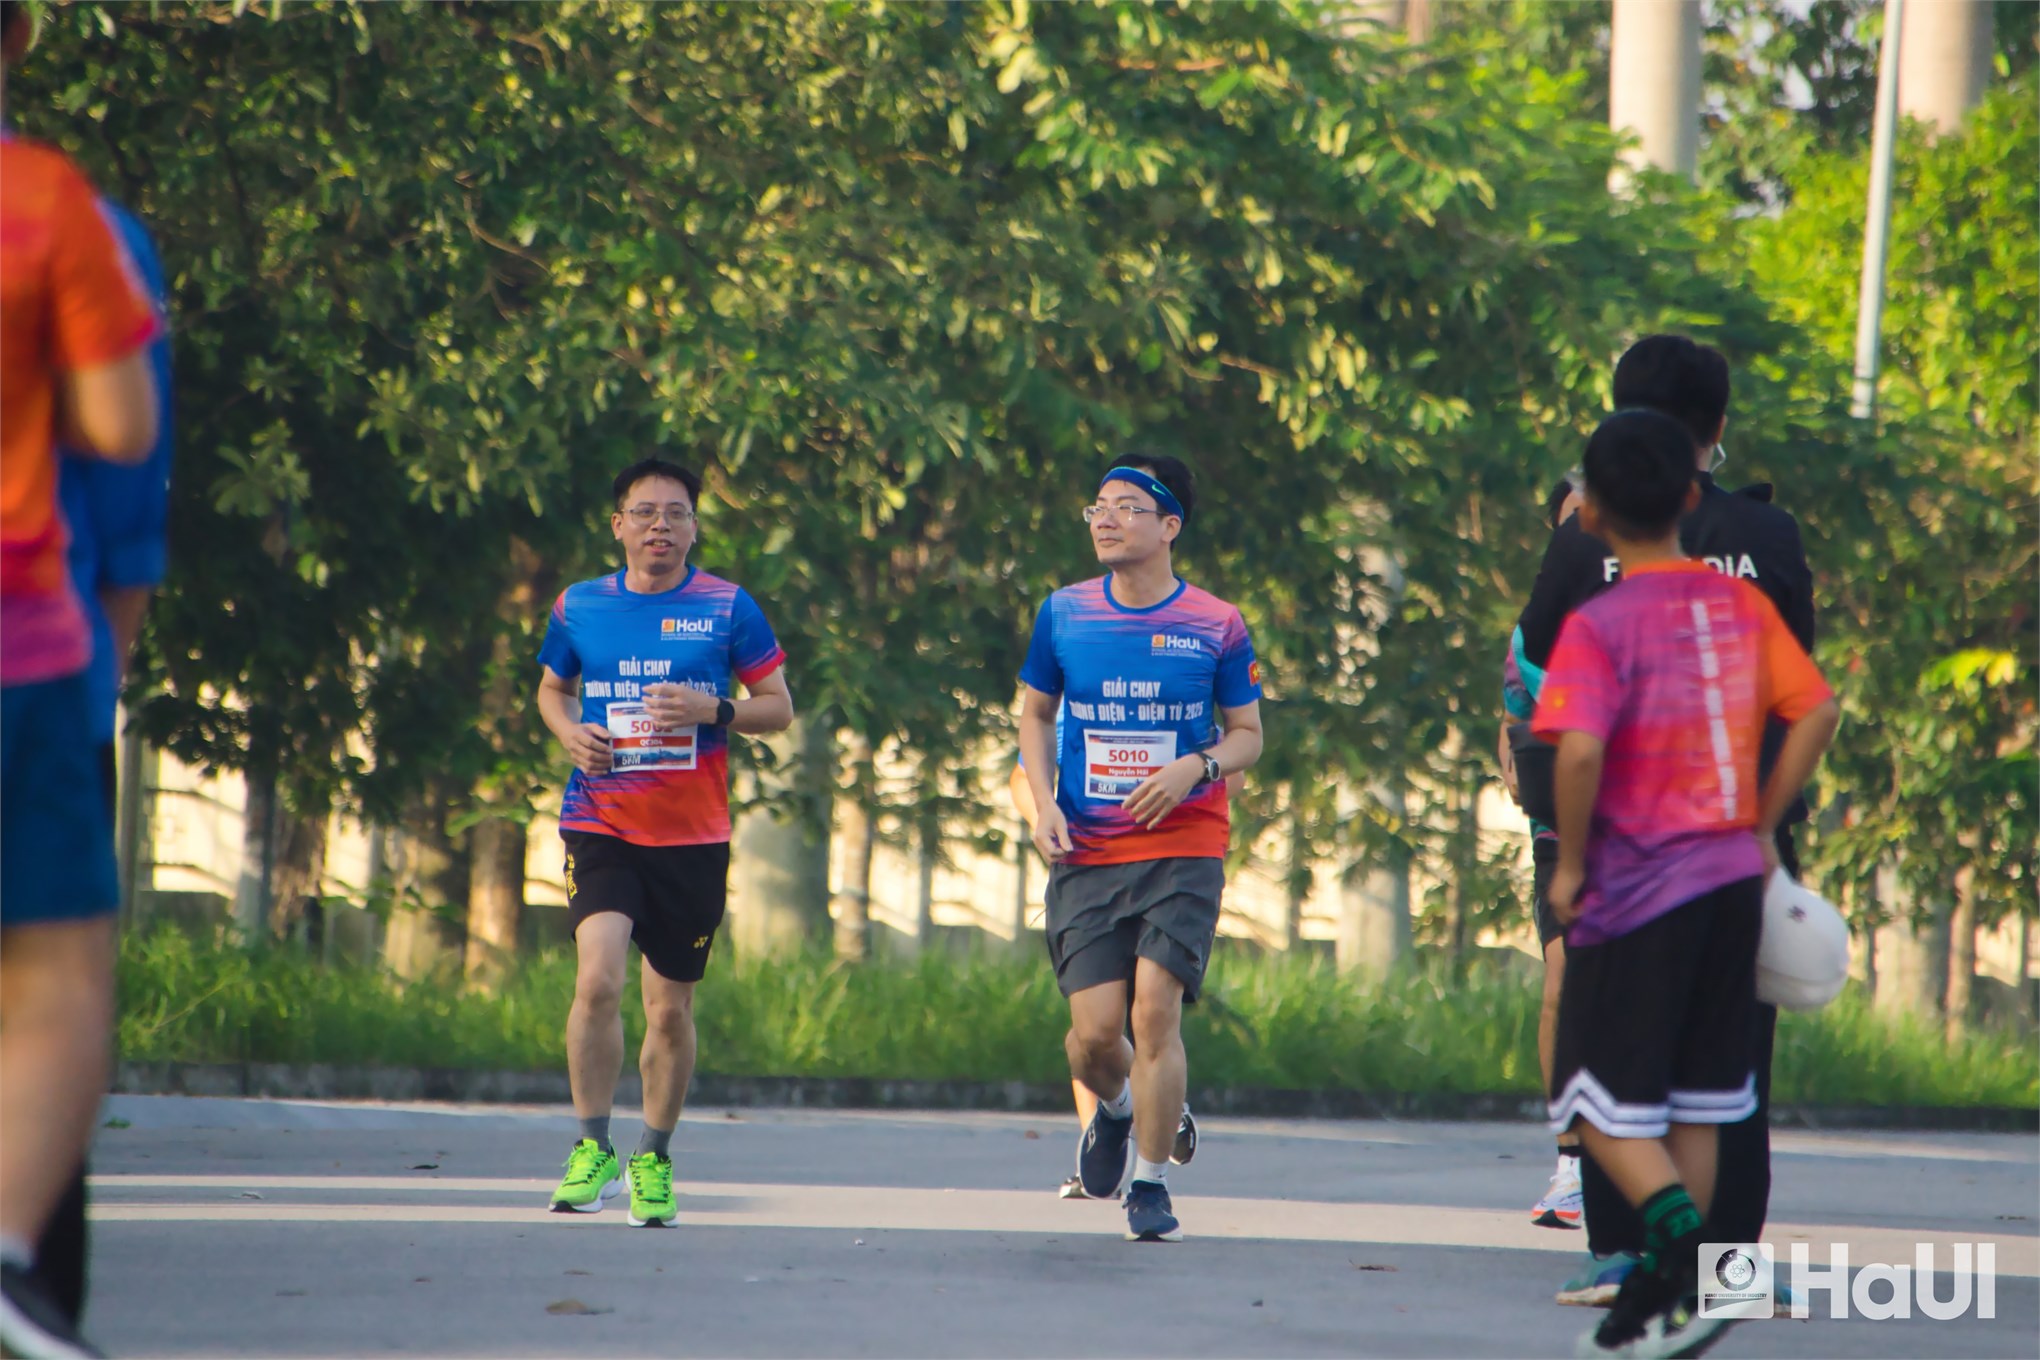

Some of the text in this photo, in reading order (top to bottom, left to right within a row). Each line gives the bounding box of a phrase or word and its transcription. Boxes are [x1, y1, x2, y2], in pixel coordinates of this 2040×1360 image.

[676, 619, 712, 632] HaUI
[1166, 635, 1200, 650] HaUI
[643, 660, 671, 679] CHẠY
[1130, 681, 1161, 701] CHẠY
[1108, 749, 1149, 763] 5010
[1097, 783, 1117, 794] 5KM
